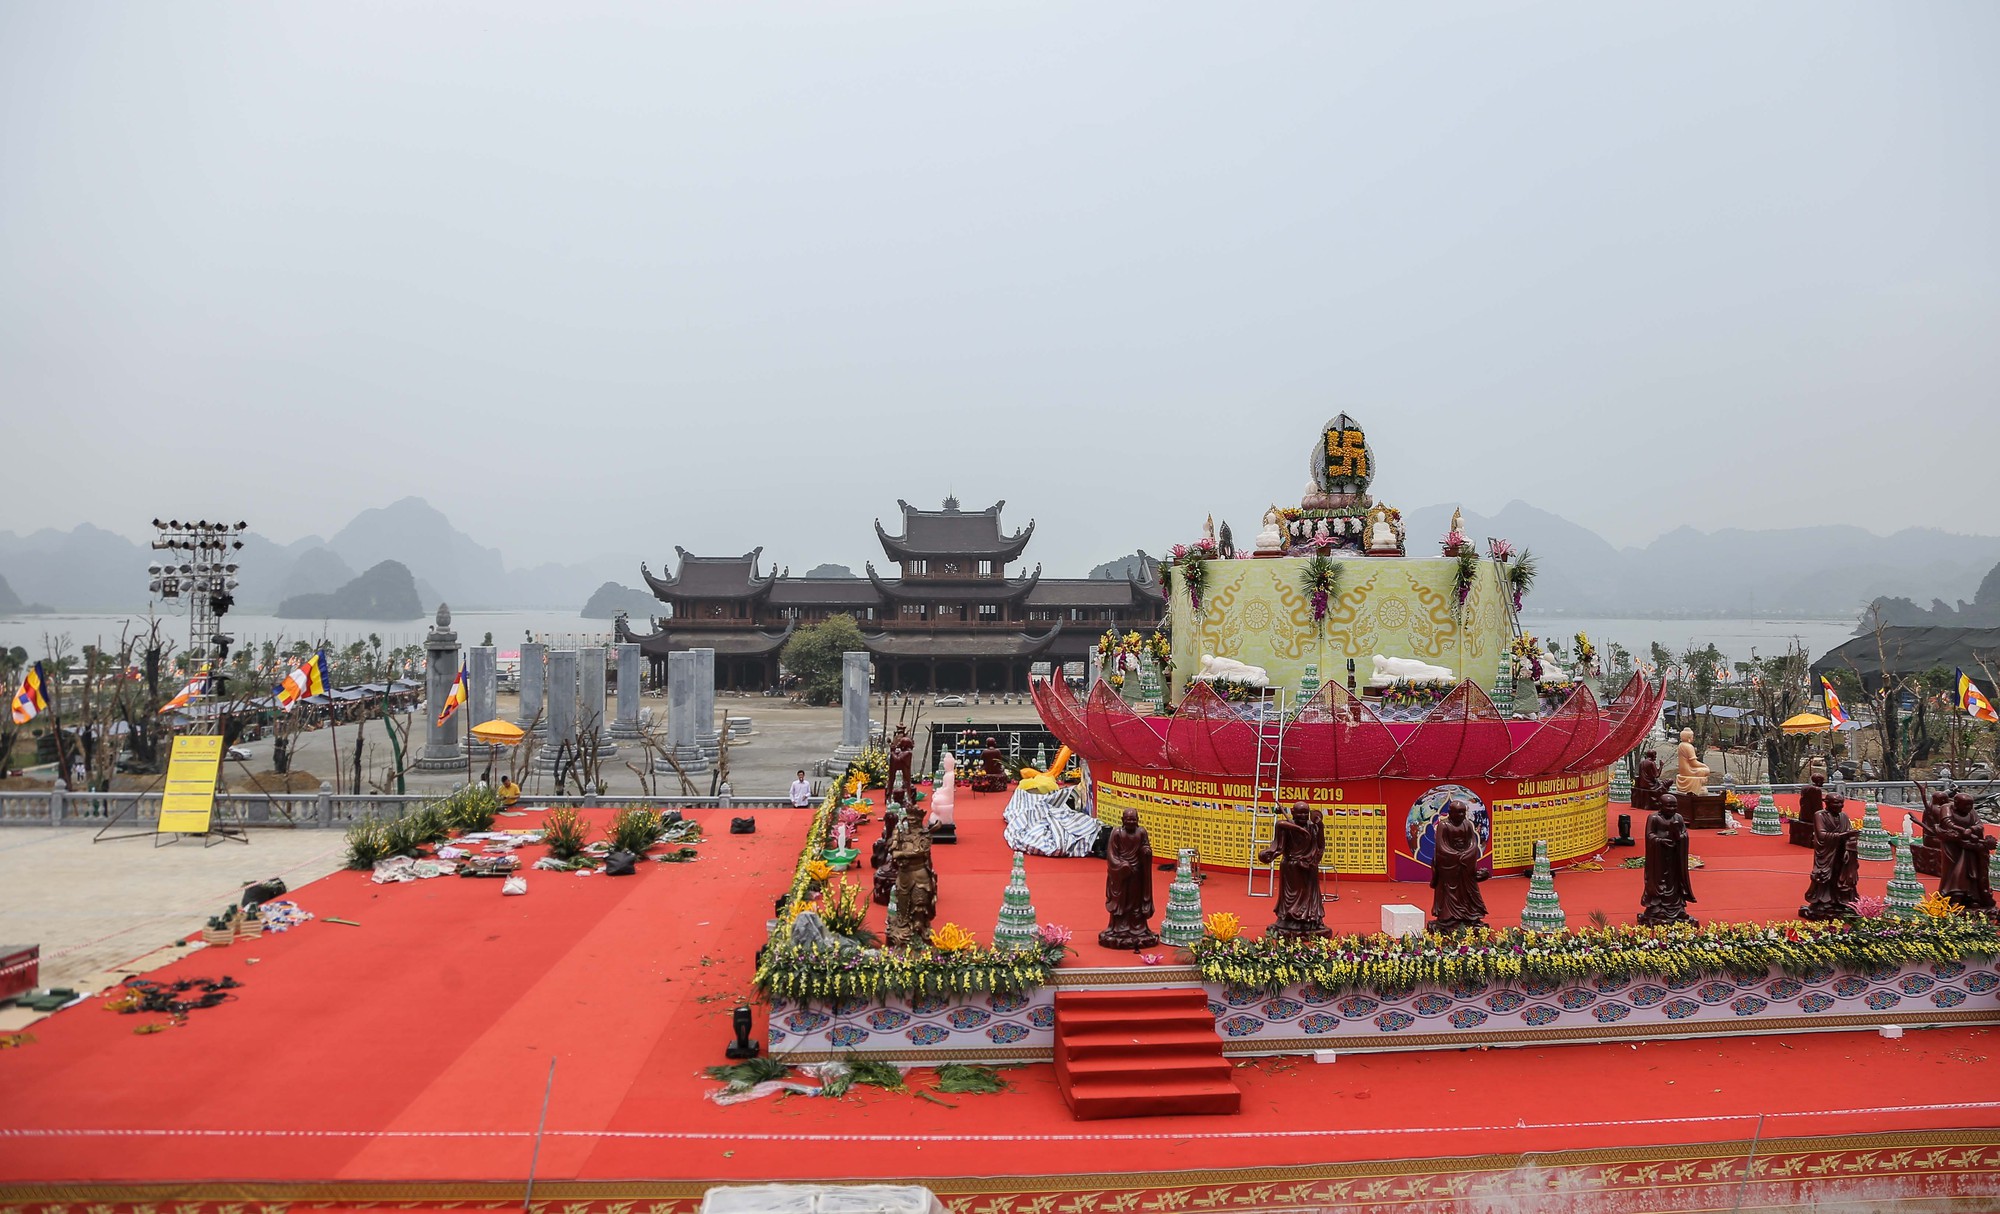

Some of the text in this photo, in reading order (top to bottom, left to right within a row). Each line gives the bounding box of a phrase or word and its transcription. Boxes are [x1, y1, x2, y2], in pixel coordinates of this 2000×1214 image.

[1112, 770, 1140, 787] PRAYING
[1142, 775, 1157, 789] FOR
[1171, 779, 1220, 796] PEACEFUL
[1272, 786, 1310, 801] VESAK
[1313, 787, 1344, 801] 2019
[1536, 776, 1566, 794] NGUYỆN
[1566, 776, 1580, 790] CHO
